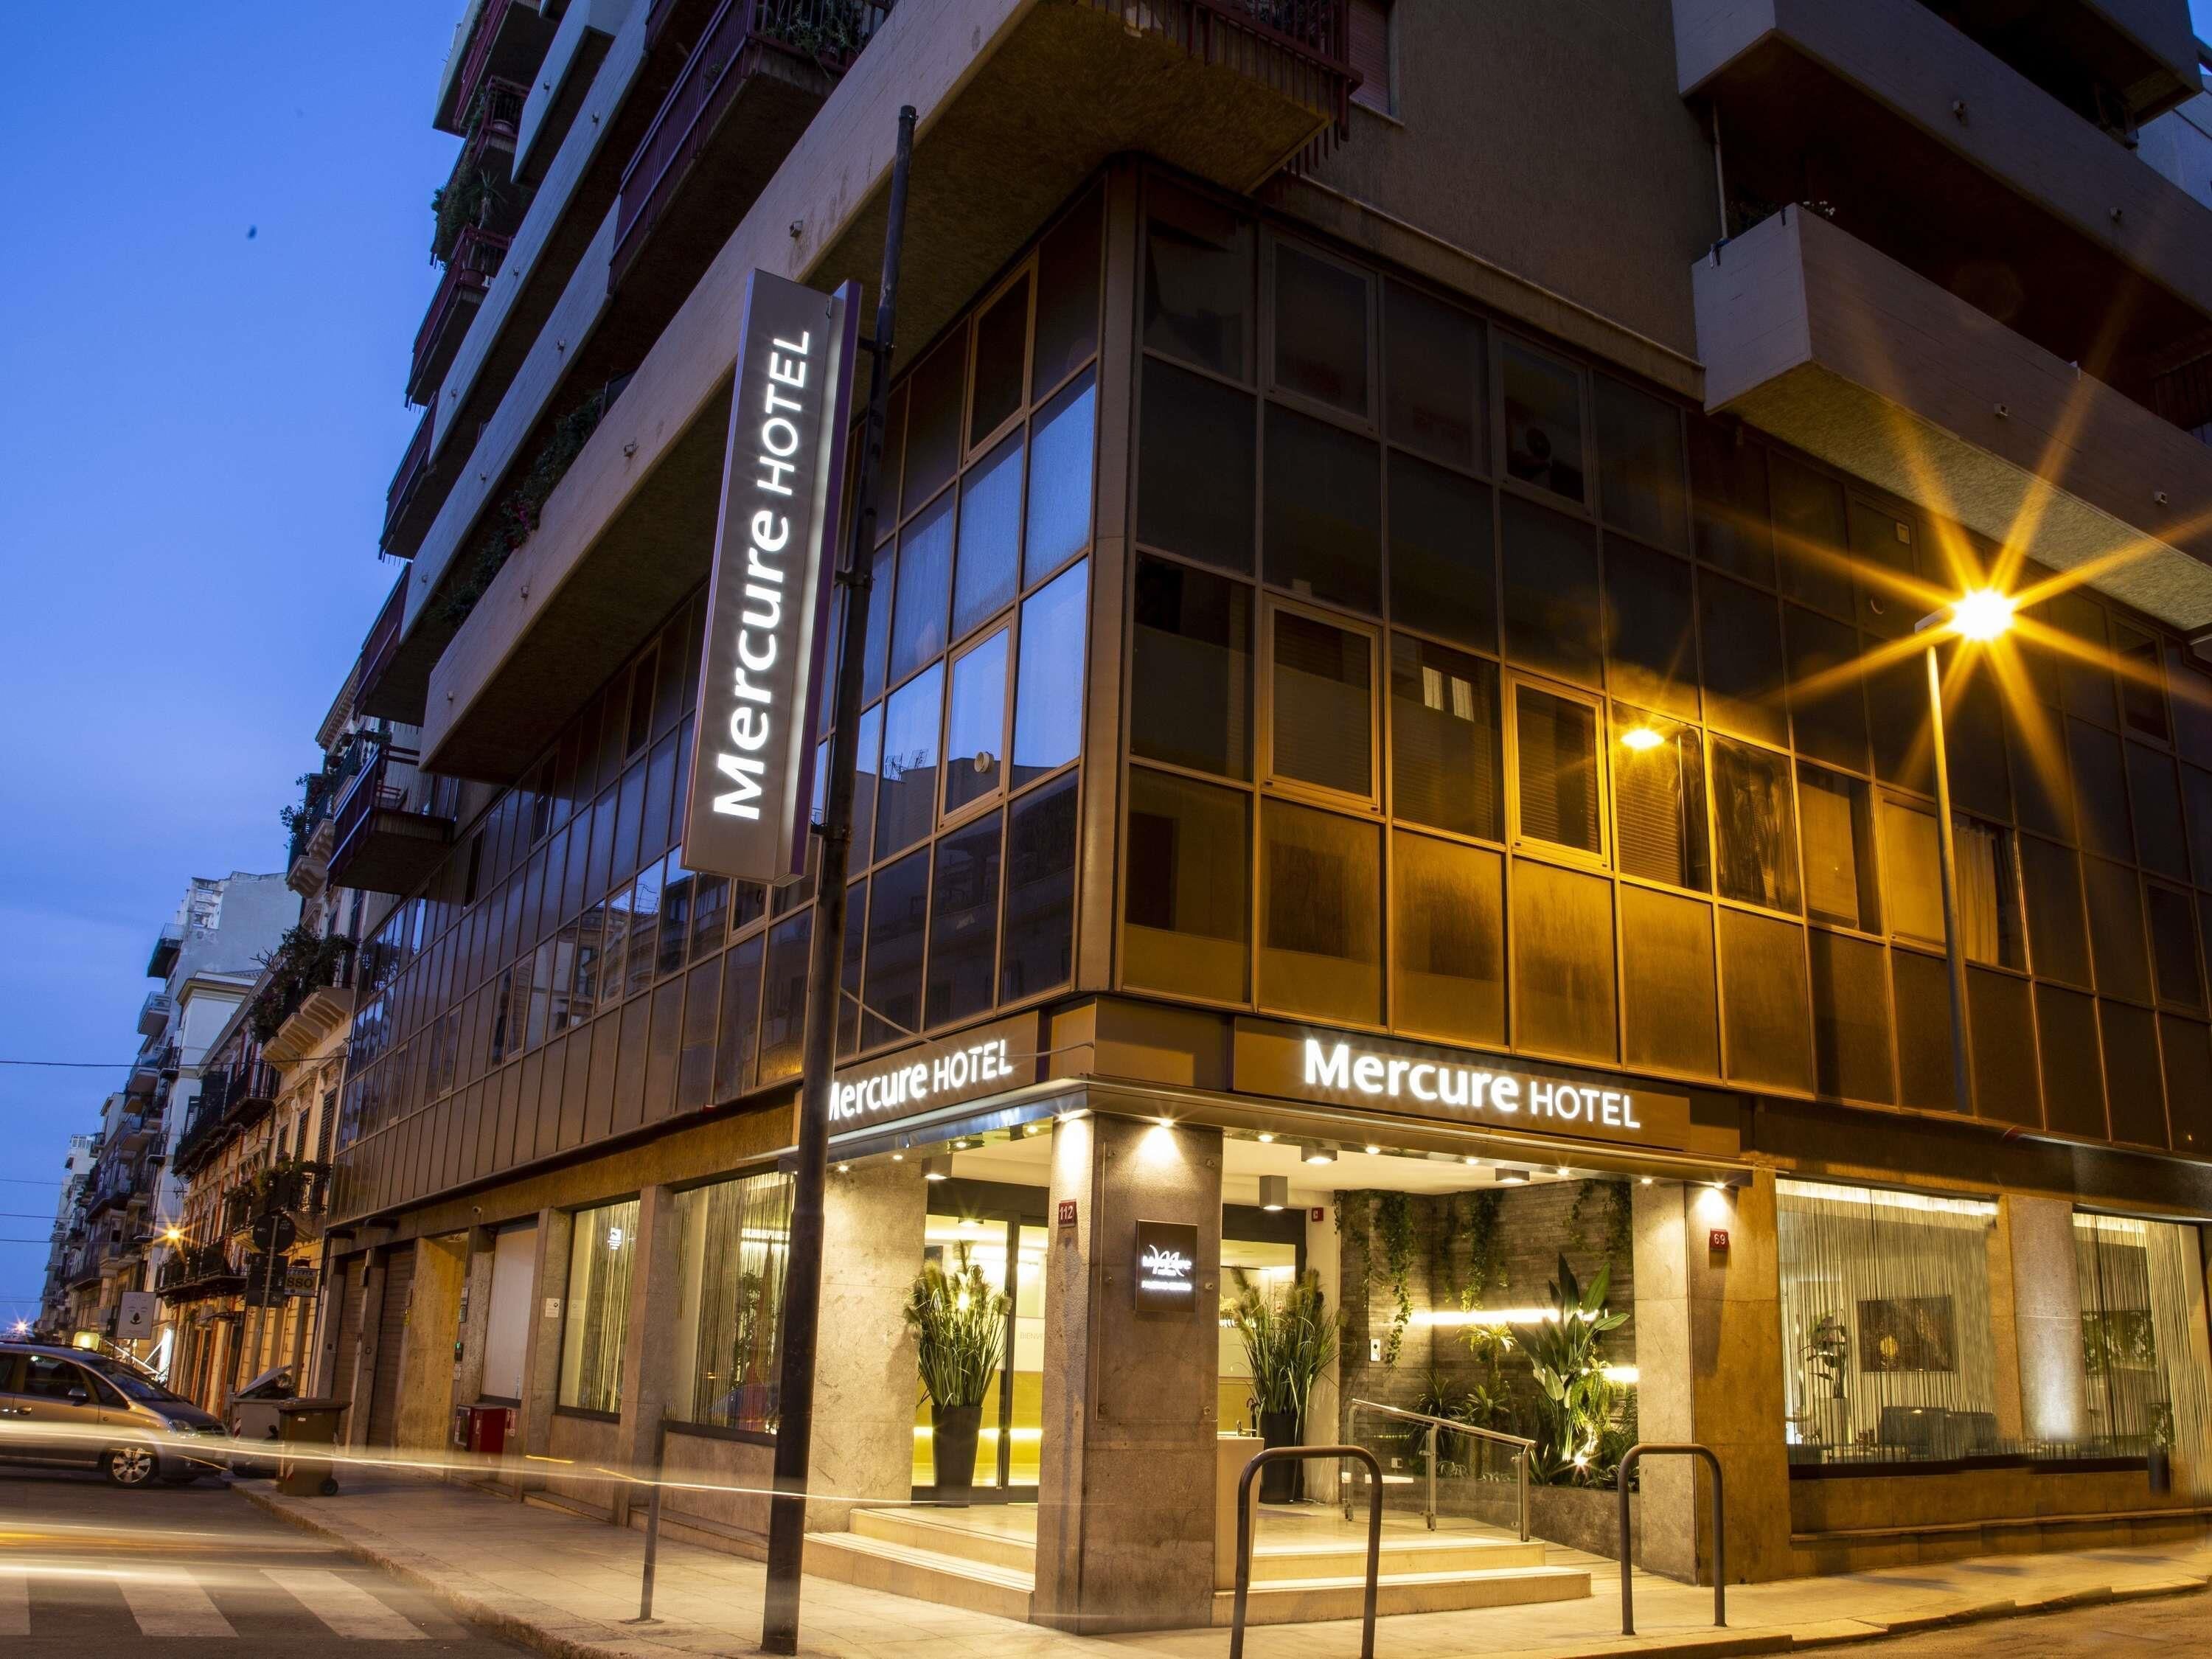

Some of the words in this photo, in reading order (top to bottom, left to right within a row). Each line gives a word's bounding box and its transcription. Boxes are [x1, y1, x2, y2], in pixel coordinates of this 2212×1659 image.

[713, 510, 789, 820] Mercure
[757, 331, 810, 495] HOTEL
[933, 1039, 1013, 1093] HOTEL
[1305, 1039, 1519, 1112] Mercure
[1530, 1081, 1641, 1128] HOTEL
[1059, 1205, 1074, 1220] 112
[1714, 1233, 1726, 1245] 69
